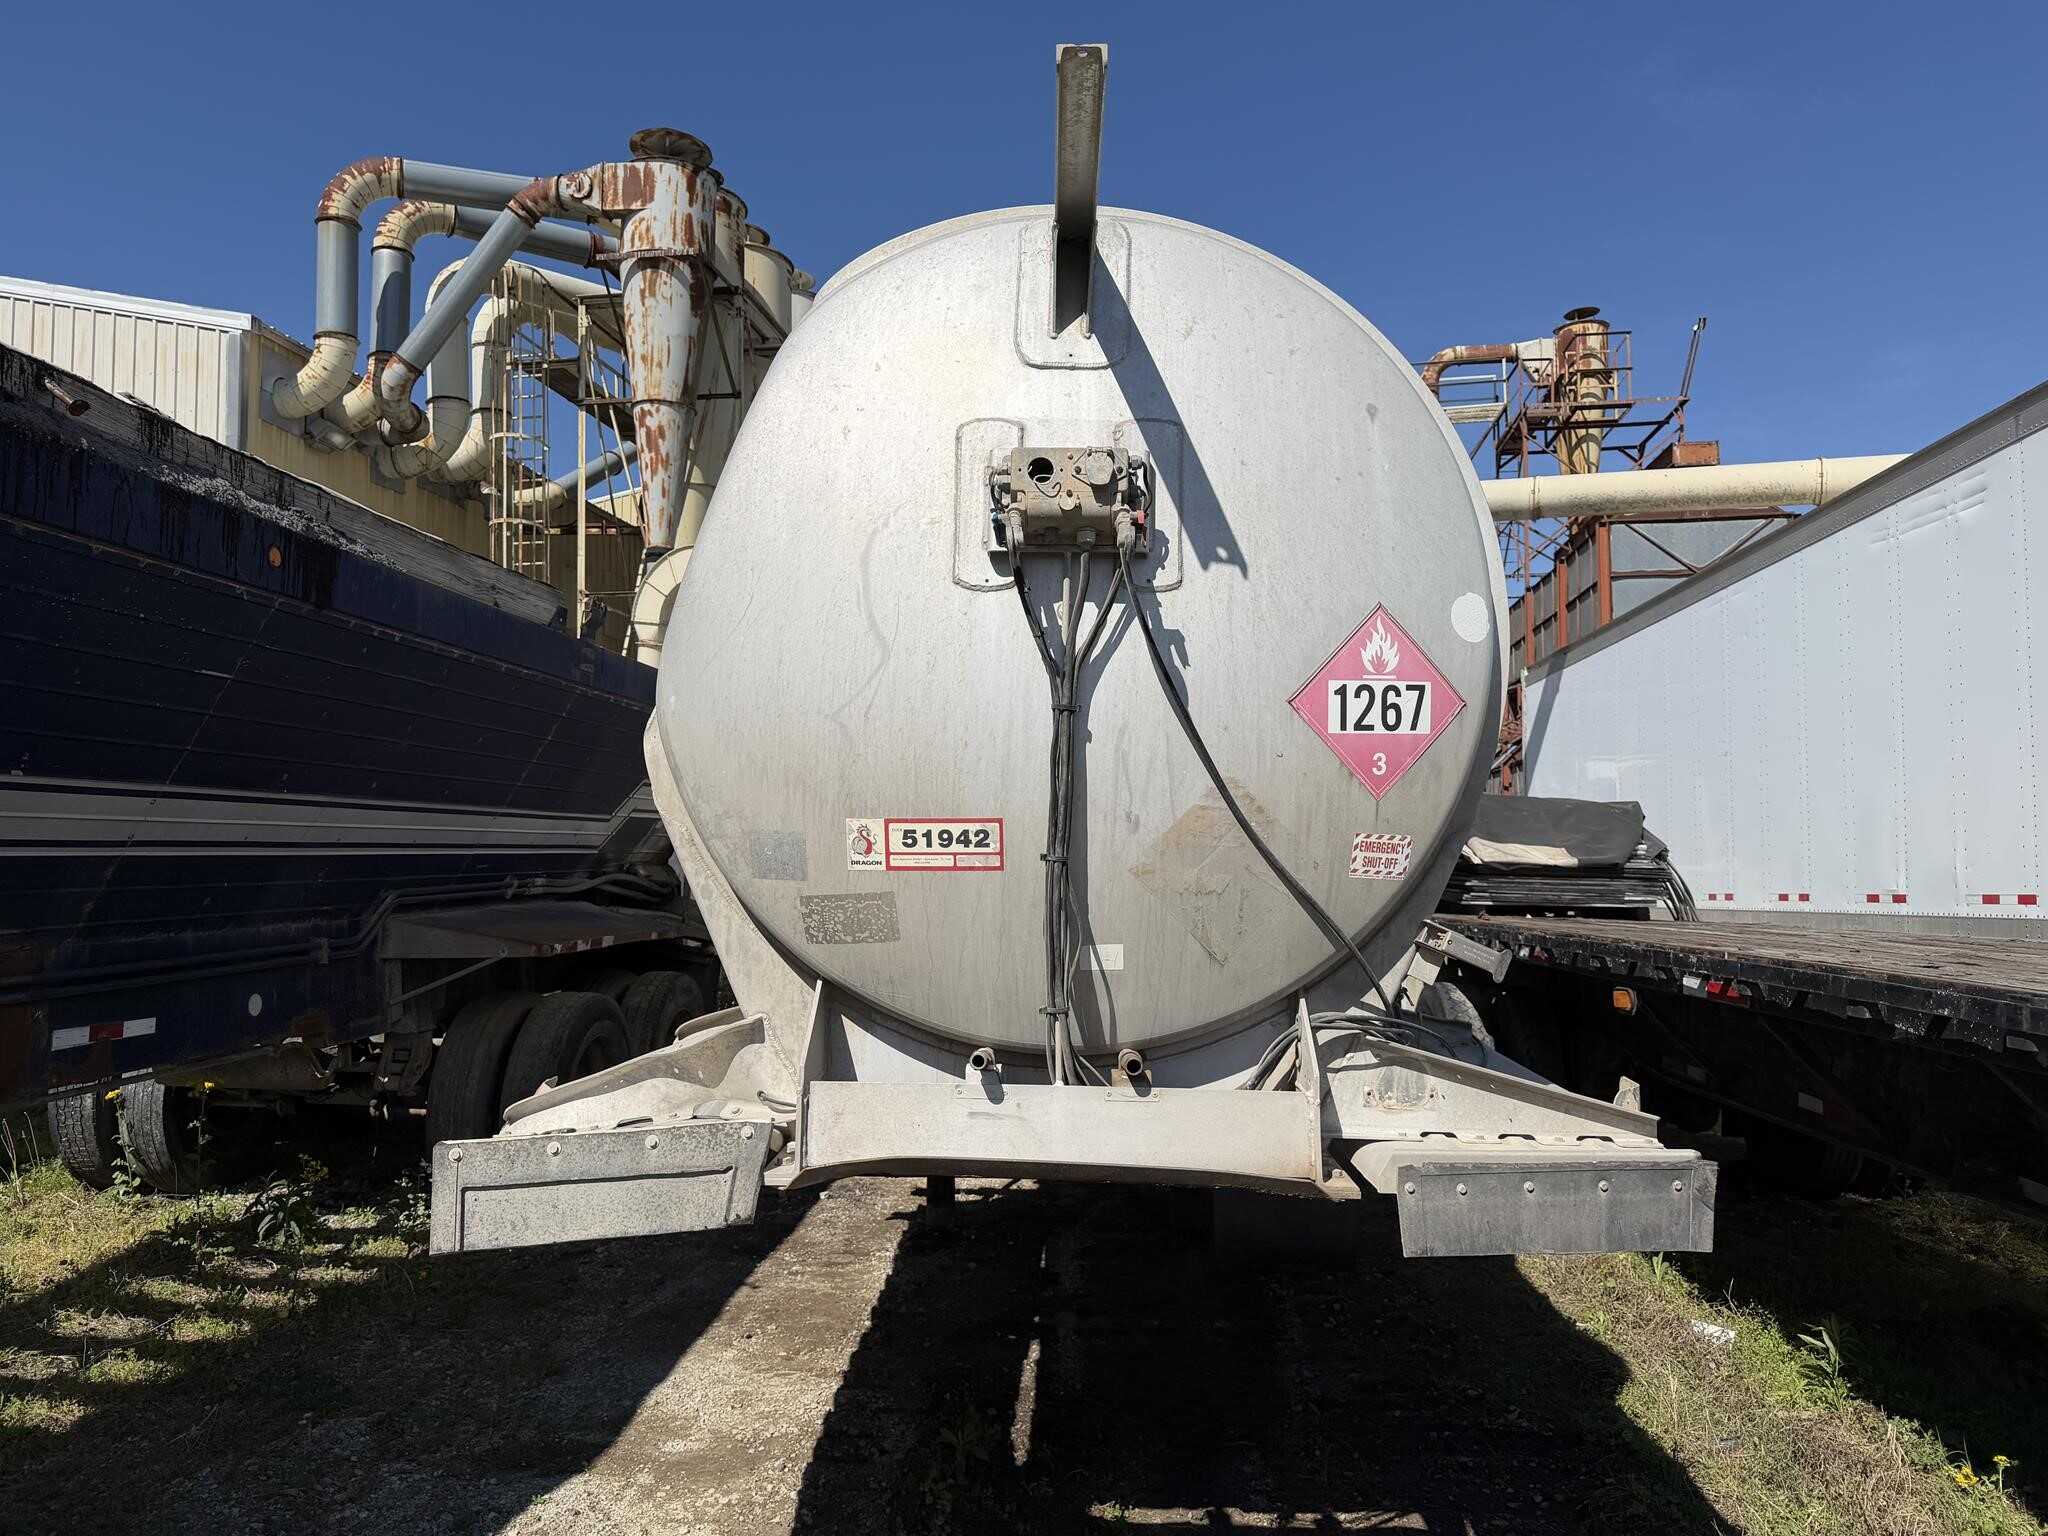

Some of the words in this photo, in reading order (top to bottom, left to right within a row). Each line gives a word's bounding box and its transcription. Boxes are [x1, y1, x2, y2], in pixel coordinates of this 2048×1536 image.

[1334, 684, 1426, 732] 1267
[1372, 752, 1387, 775] 3
[901, 829, 991, 848] 51942
[1359, 840, 1407, 855] EMERGENCY
[1362, 856, 1399, 870] SHUT-OFF
